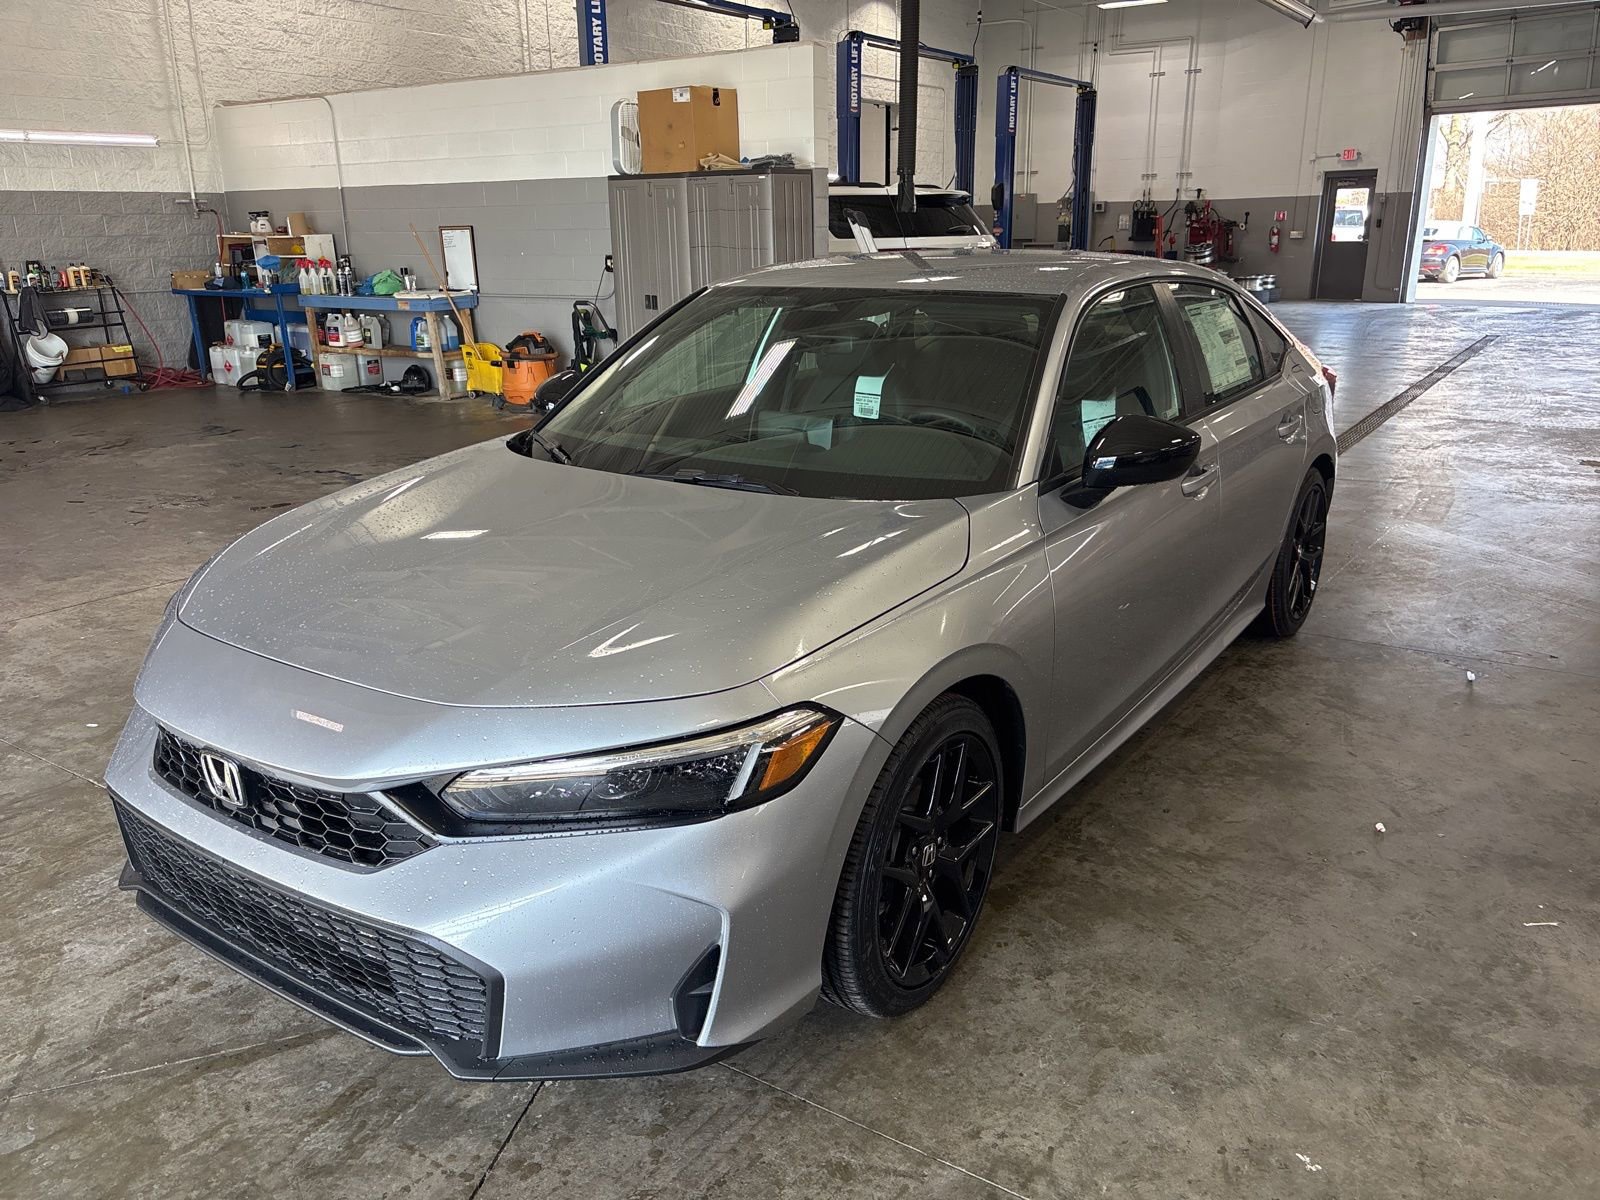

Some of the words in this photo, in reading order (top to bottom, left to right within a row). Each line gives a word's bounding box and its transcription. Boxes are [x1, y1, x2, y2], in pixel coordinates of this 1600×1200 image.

[590, 0, 601, 14] LI
[592, 17, 604, 66] OTARY
[851, 41, 859, 64] LIFT
[850, 67, 859, 107] ROTARY
